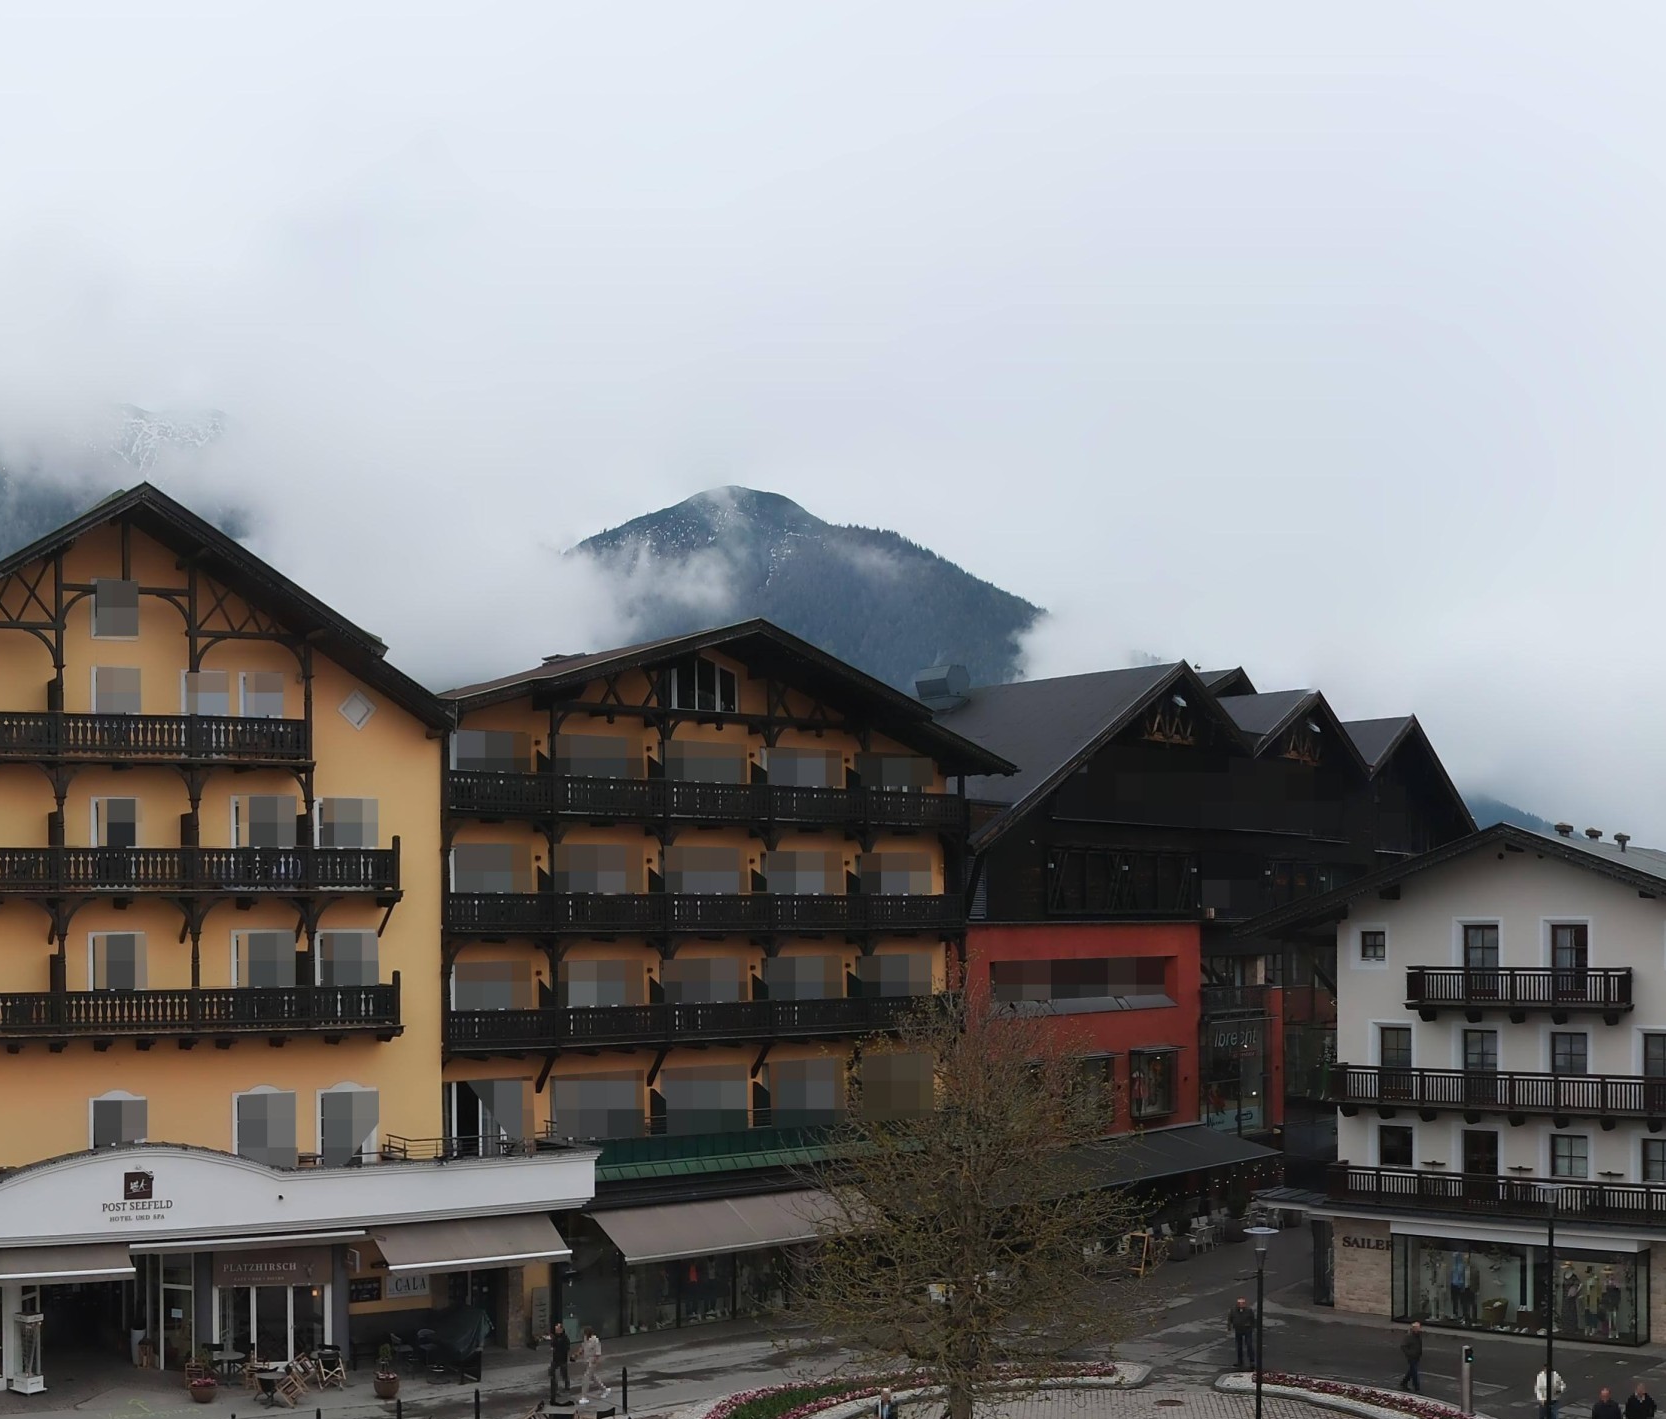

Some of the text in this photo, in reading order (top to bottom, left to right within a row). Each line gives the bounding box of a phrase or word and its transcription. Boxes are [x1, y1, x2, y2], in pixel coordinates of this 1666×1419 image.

[102, 1200, 173, 1213] POST SEEFELD
[223, 1262, 298, 1273] PLATZHIRSCH
